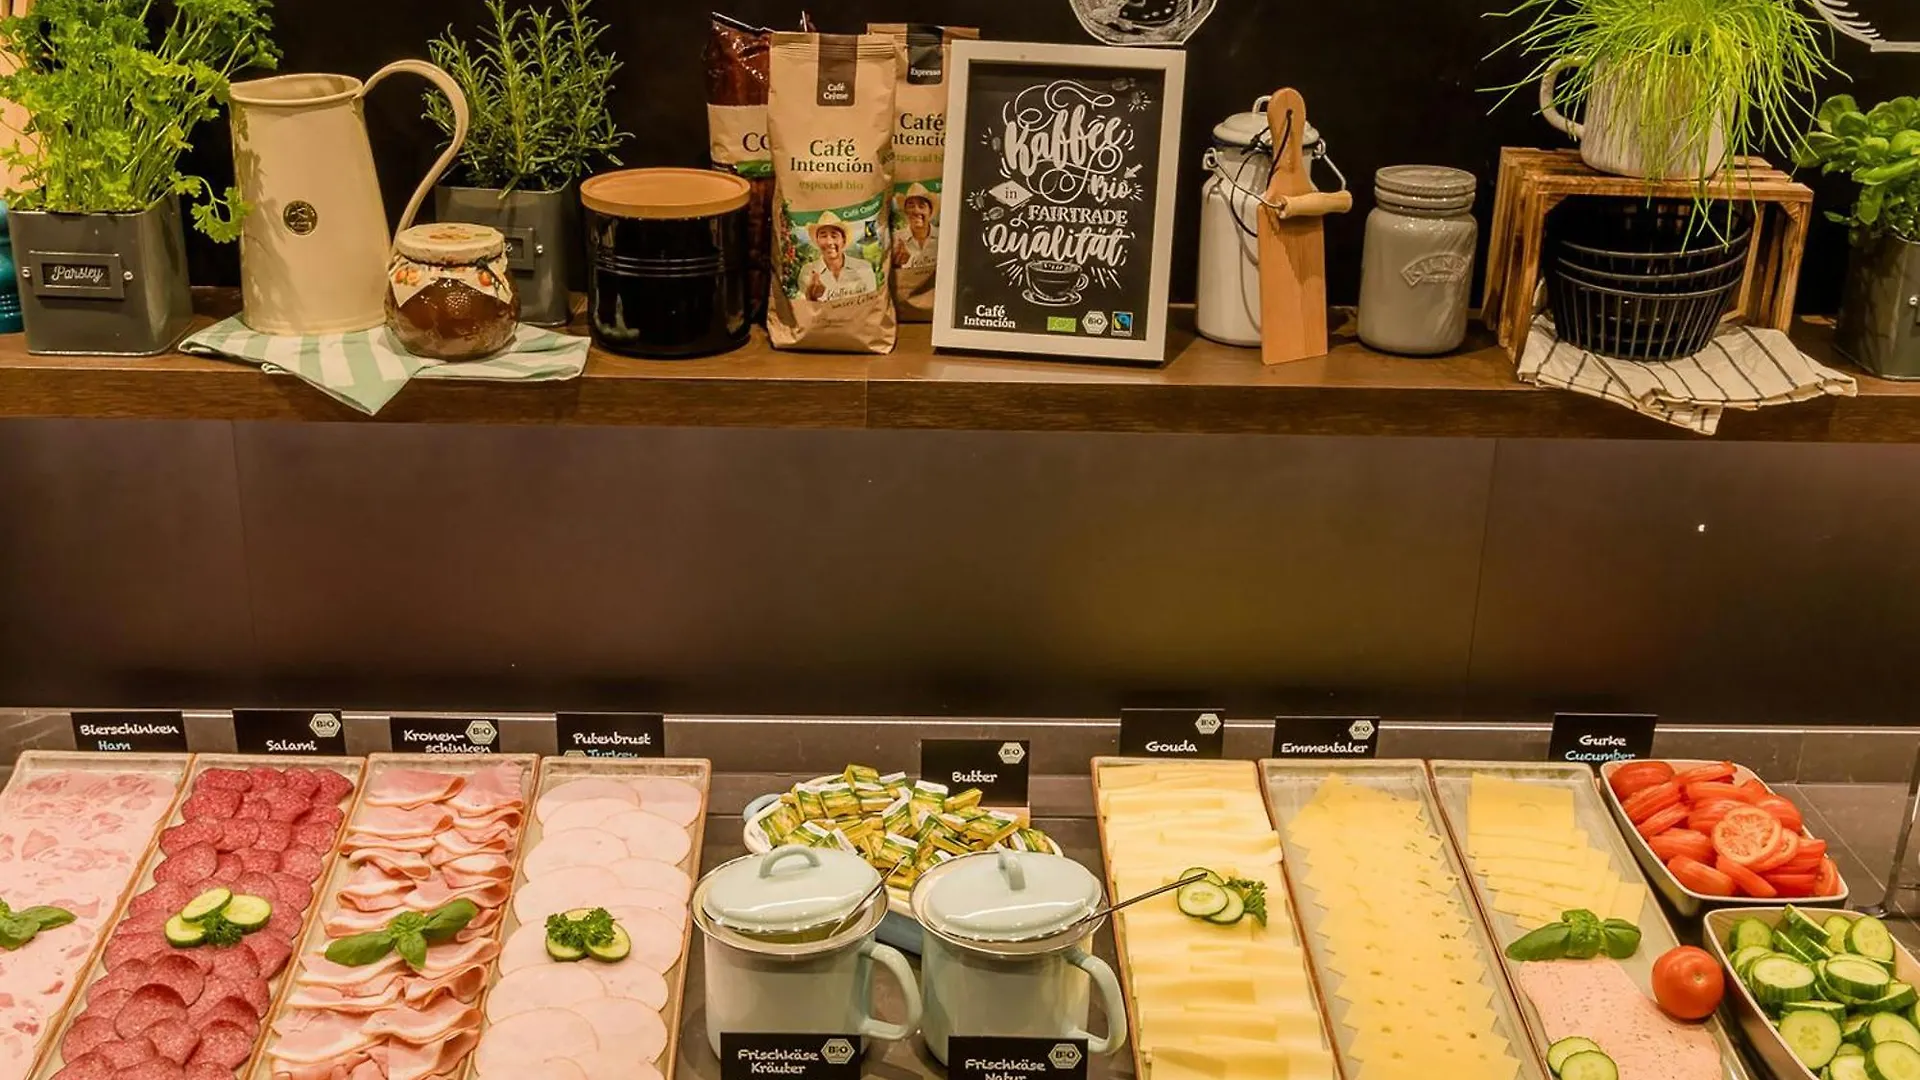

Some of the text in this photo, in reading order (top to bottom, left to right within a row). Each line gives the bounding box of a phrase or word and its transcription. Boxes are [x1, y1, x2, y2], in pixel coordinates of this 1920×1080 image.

[900, 112, 944, 131] Café
[809, 138, 855, 157] Café
[791, 157, 873, 173] Intención
[1005, 187, 1018, 200] in
[1091, 174, 1132, 202] Bio
[1028, 204, 1128, 225] FAIRTRADE
[988, 223, 1132, 266] Qualität
[51, 266, 104, 283] Parsley
[976, 304, 1005, 318] Café
[964, 316, 1016, 328] Intención
[80, 723, 179, 736] Bierschinken
[403, 729, 465, 741] Kronen-
[573, 731, 651, 745] Putenbrust
[1579, 734, 1626, 746] Gurke
[98, 740, 131, 751] Ham
[266, 739, 317, 751] Salami
[425, 743, 491, 753] schinken
[1145, 739, 1198, 752] Gouda
[1281, 741, 1369, 753] Emmentaler
[1565, 748, 1636, 761] Cucumber
[952, 769, 998, 782] Butter
[738, 1048, 819, 1061] Frischkäse
[751, 1062, 806, 1074] Kräuter
[965, 1058, 1046, 1071] Frischkäse
